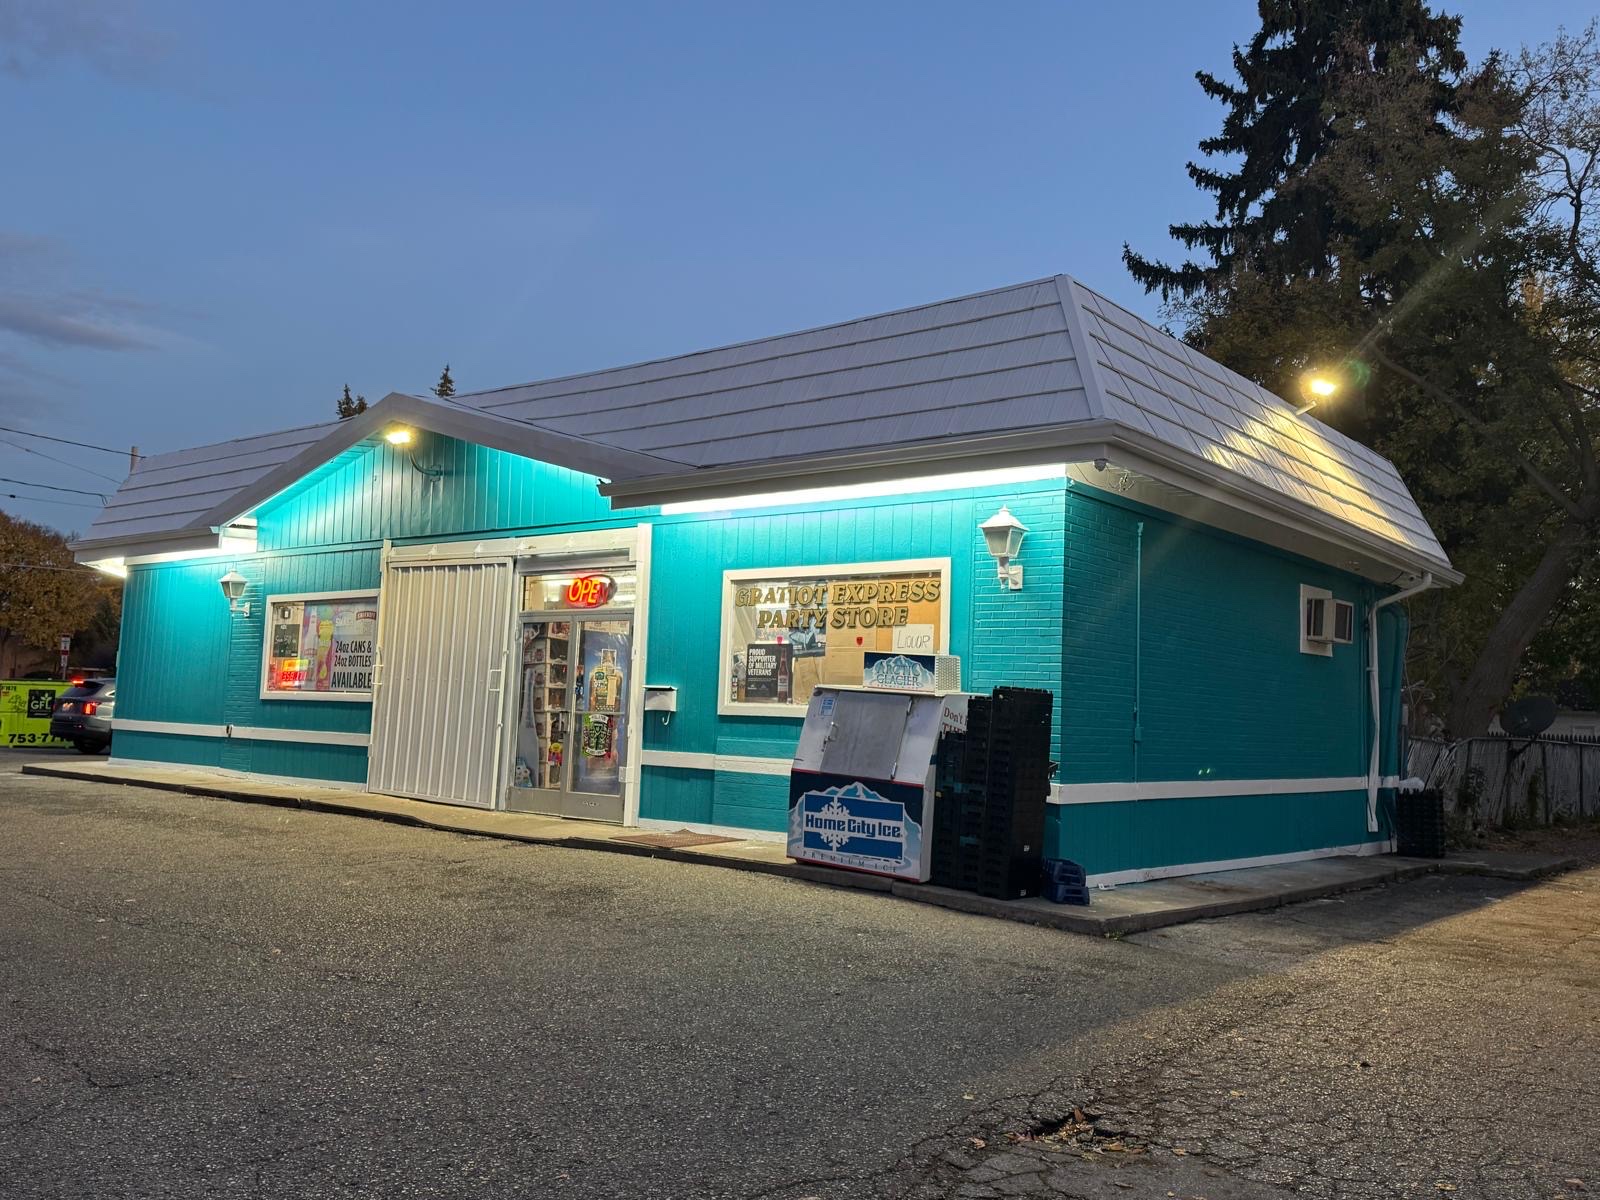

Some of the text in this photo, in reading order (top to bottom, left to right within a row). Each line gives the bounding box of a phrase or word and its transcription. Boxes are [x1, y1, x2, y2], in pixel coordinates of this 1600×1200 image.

[569, 578, 608, 603] OPEN
[736, 580, 940, 607] GRATIOT EXPRESS
[757, 606, 908, 629] PARTY STORE
[335, 640, 372, 653] 24oz CANS &
[749, 648, 766, 656] PROUD
[334, 655, 372, 667] 24oz BOTTLES
[748, 655, 776, 663] SUPPORTER
[748, 668, 772, 676] VETERANS
[877, 661, 921, 677] ARCTIC
[331, 672, 372, 688] AVAILABLE
[877, 674, 919, 687] GLACIER
[31, 700, 51, 710] GFL
[943, 706, 963, 725] Don't
[805, 814, 900, 838] Home City Ice
[803, 850, 865, 866] PREMIUM
